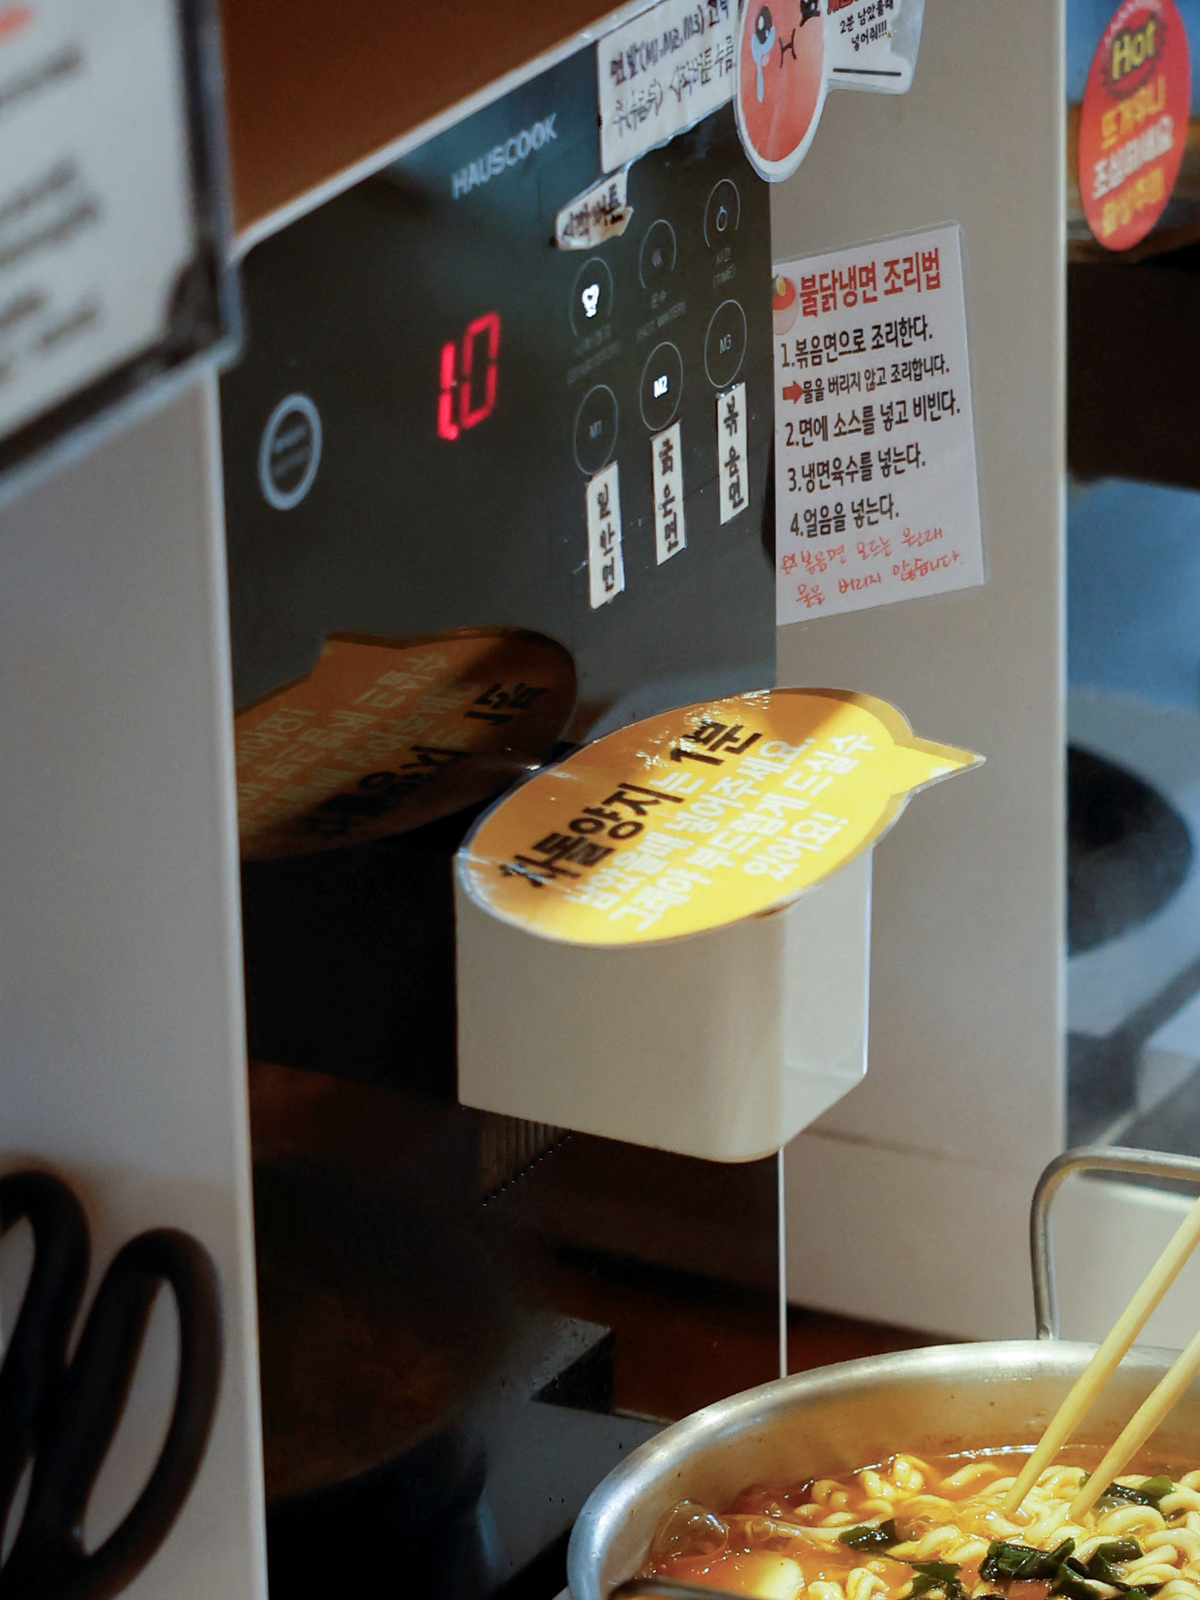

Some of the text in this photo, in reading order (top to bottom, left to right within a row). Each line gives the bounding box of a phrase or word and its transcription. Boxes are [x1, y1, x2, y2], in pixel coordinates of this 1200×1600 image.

[452, 113, 558, 198] HAUSCOOK
[800, 247, 941, 317] 불닭냉면 조리법
[871, 314, 933, 350] 조리한다.
[653, 374, 668, 398] M2
[803, 353, 950, 405] 물을 버리지 않고 조리합니다.
[833, 404, 875, 437] 소스를
[880, 400, 909, 432] 넣고
[912, 389, 961, 421] 비빈다.
[878, 442, 926, 478] 넣는다.
[851, 493, 900, 529] 넣는다.
[838, 573, 882, 594] 버리지
[670, 720, 763, 766] 1분
[684, 792, 811, 870] 부드럽게
[782, 733, 875, 796] 드실수
[743, 811, 850, 881] 있어요!
